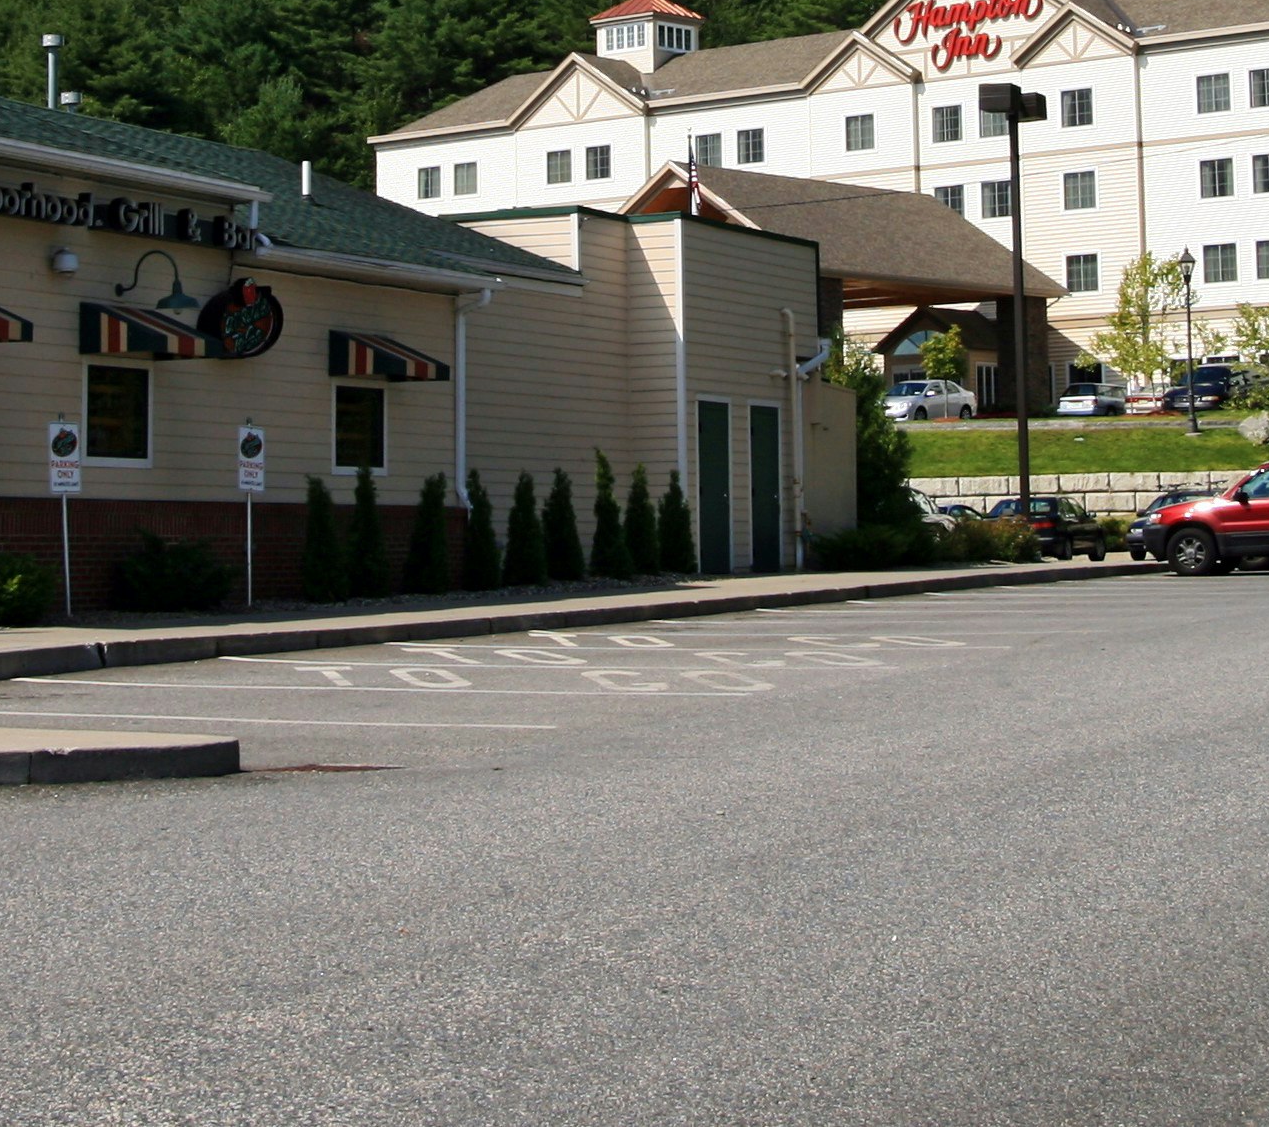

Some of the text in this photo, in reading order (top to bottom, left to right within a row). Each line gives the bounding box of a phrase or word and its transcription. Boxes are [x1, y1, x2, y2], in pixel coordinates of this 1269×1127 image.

[930, 27, 1003, 73] Inn
[118, 199, 165, 236] Grill
[186, 210, 202, 242] &
[221, 218, 257, 251] Bar
[528, 630, 967, 648] TO GO
[401, 647, 888, 667] TO GO
[295, 666, 776, 692] TO GO
